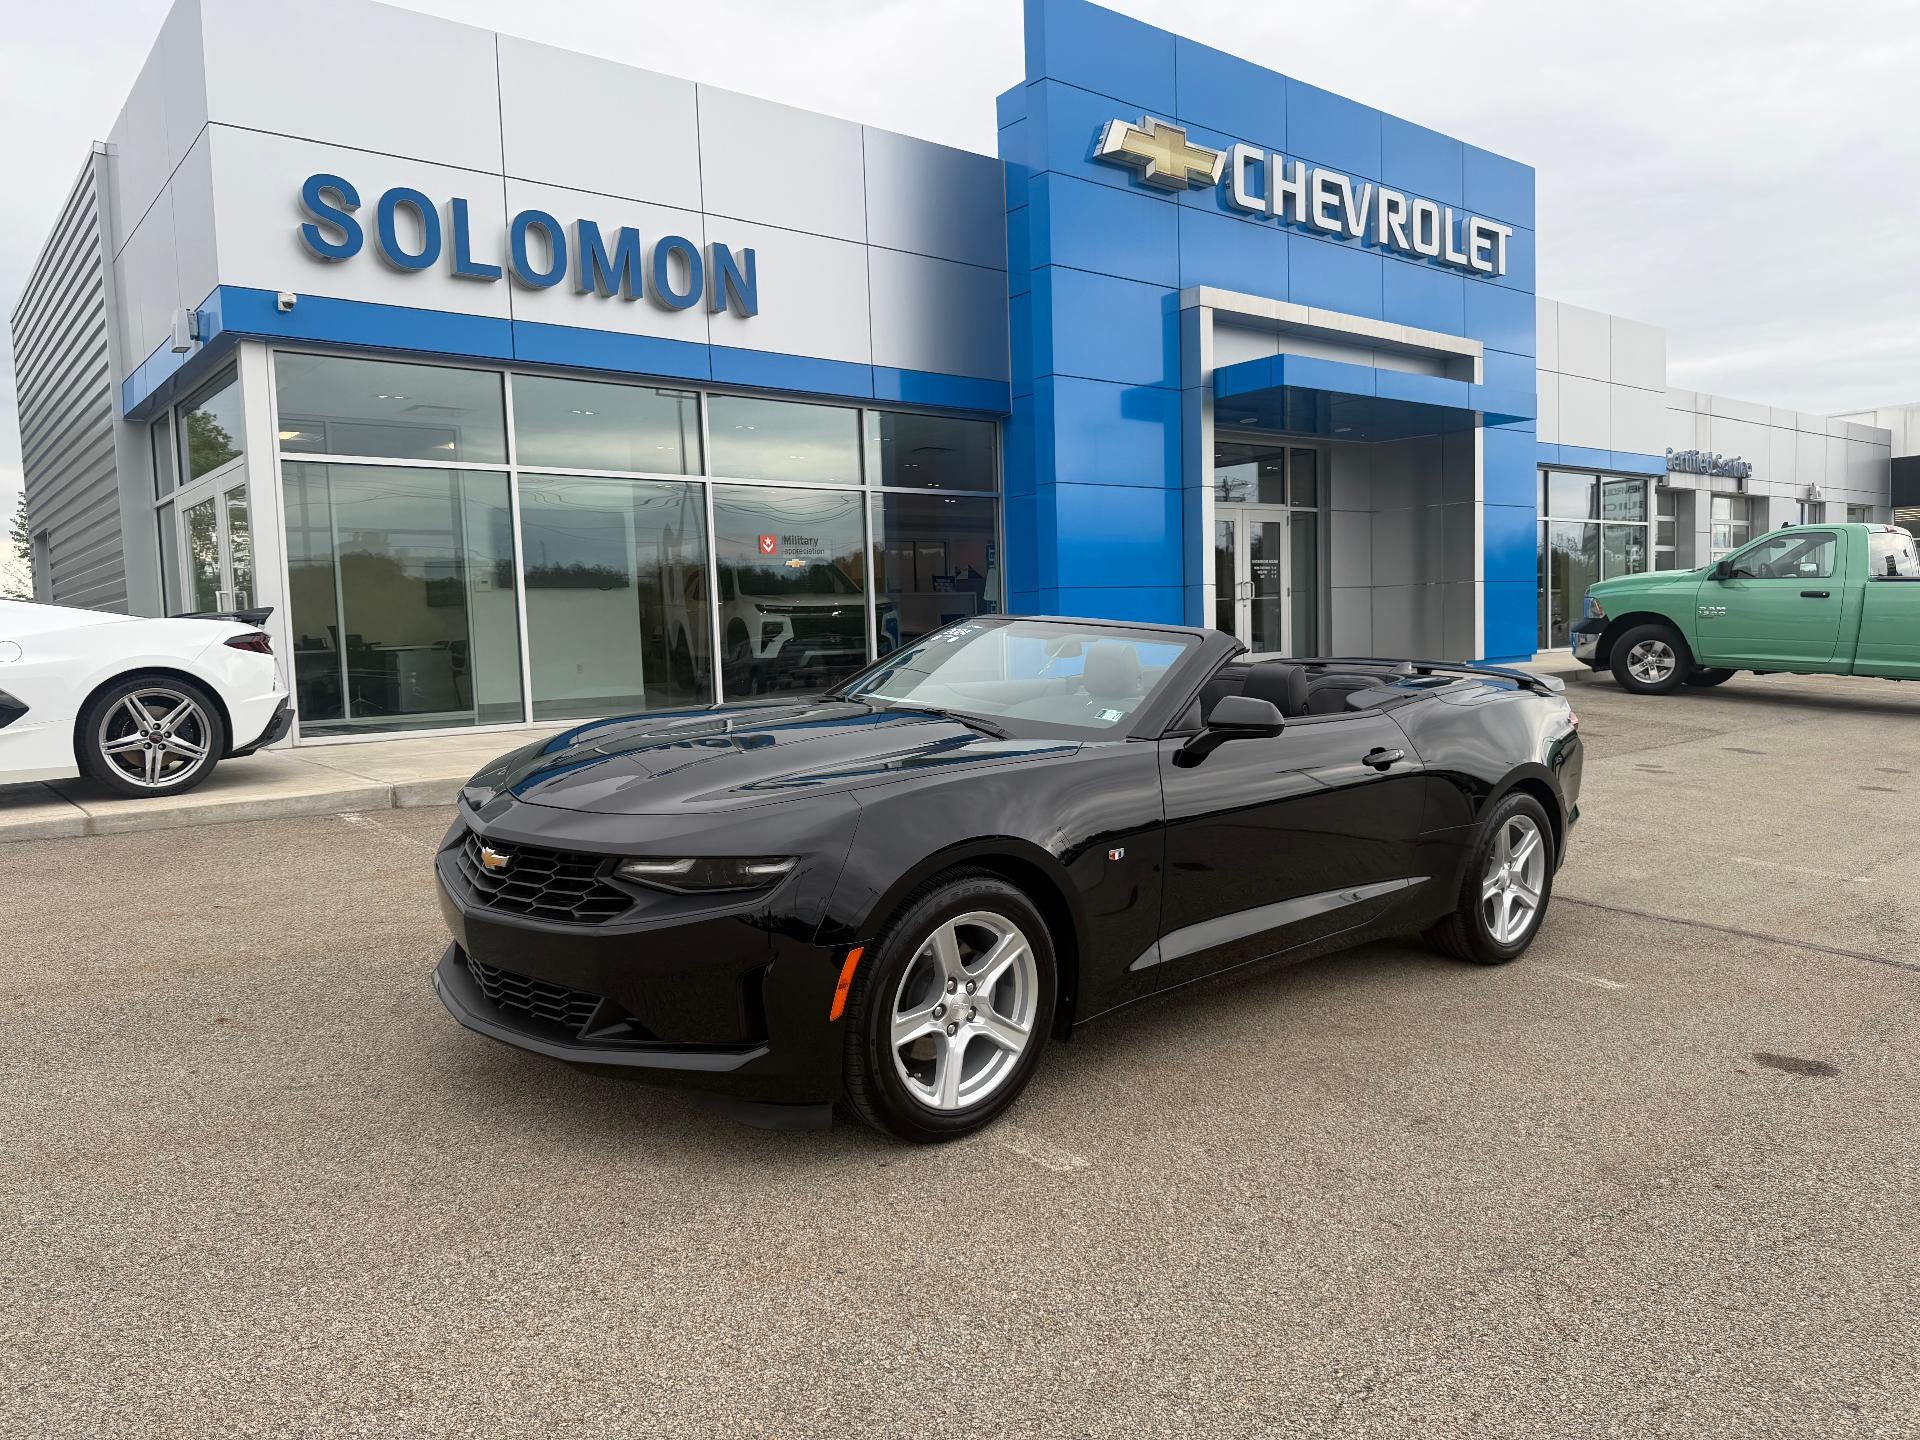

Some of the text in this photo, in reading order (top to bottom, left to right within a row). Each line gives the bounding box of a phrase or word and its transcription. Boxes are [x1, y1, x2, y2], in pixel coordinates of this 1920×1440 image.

[1226, 143, 1512, 276] CHEVROLET
[300, 173, 758, 318] SOLOMON
[1666, 447, 1712, 474] Certified
[782, 535, 819, 547] Military
[783, 548, 825, 556] appreciation
